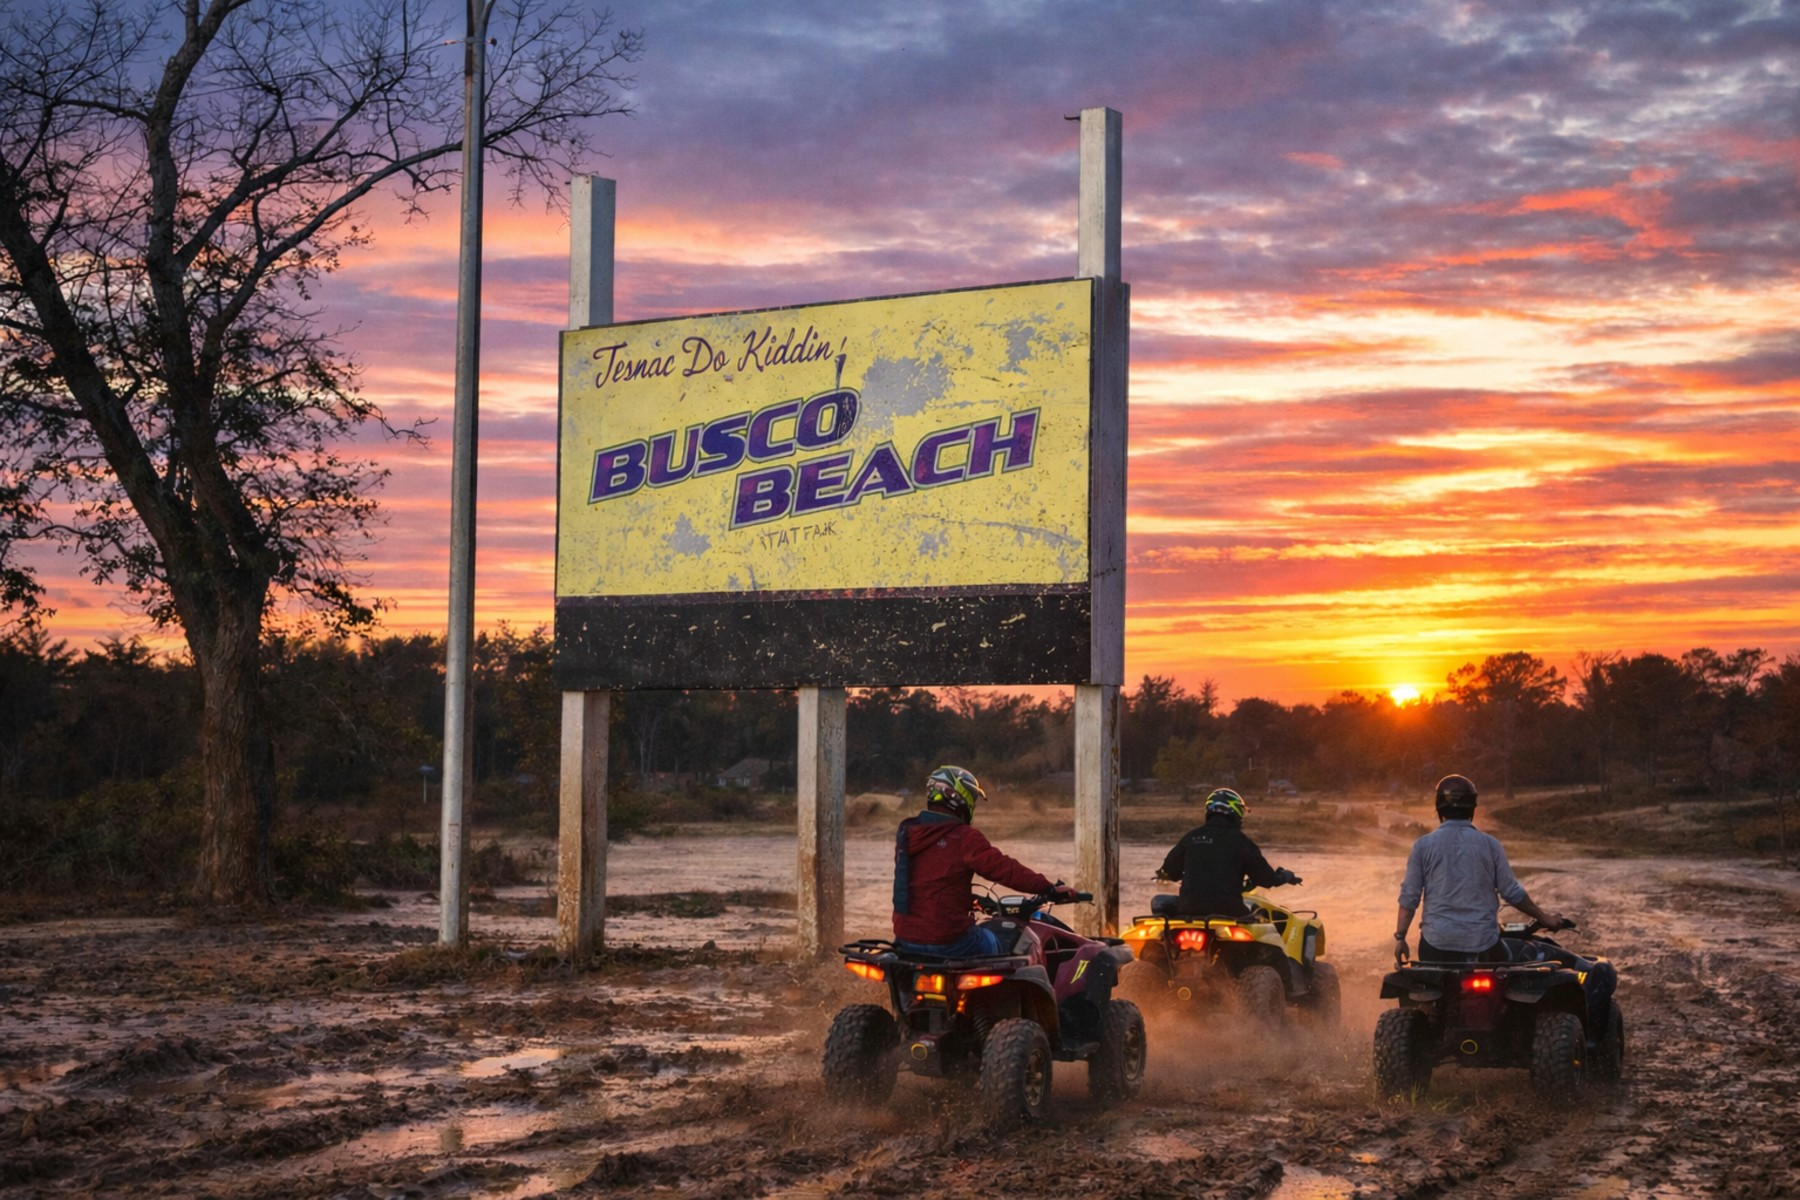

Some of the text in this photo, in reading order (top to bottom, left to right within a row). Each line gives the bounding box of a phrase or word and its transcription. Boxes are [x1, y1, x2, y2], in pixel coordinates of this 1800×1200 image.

[681, 335, 730, 377] Do
[588, 387, 860, 504] BUSCO
[729, 407, 1041, 531] BEACH
